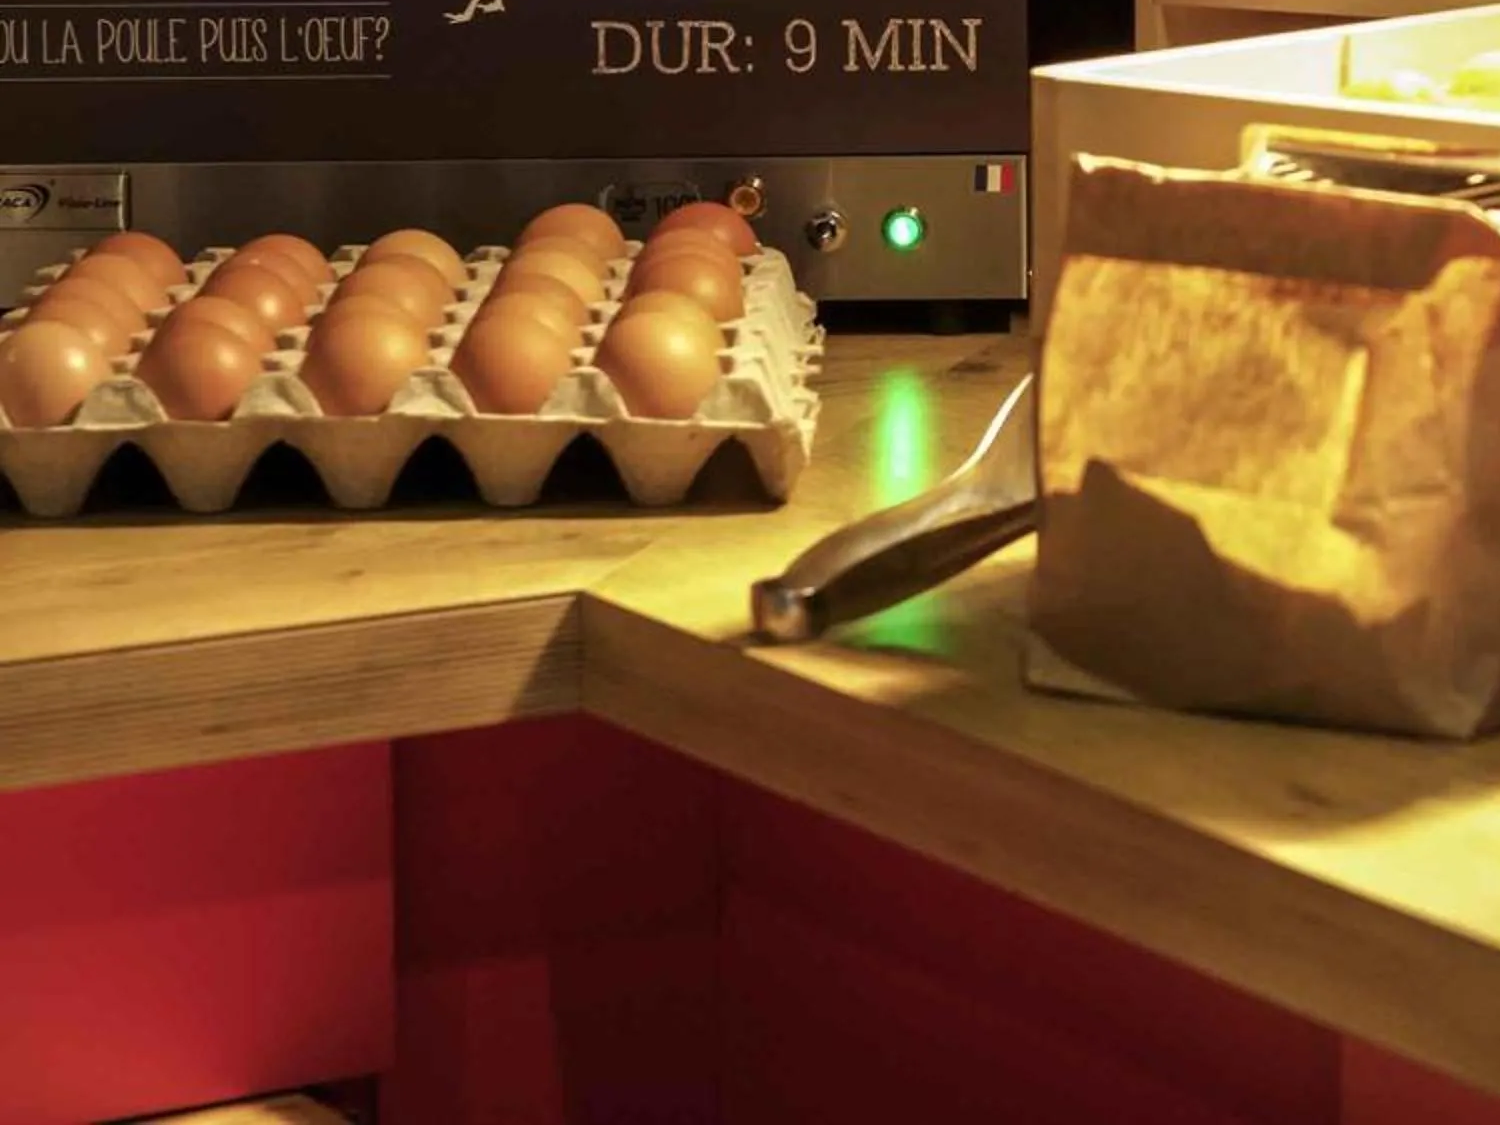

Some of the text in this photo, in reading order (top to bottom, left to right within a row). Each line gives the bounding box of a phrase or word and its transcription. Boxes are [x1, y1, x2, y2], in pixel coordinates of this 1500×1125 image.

[42, 19, 83, 65] LA
[97, 18, 188, 65] POULE
[200, 18, 268, 64] PUIS
[280, 16, 391, 63] L'OEUF?
[591, 18, 983, 74] DUR: 9 MIN
